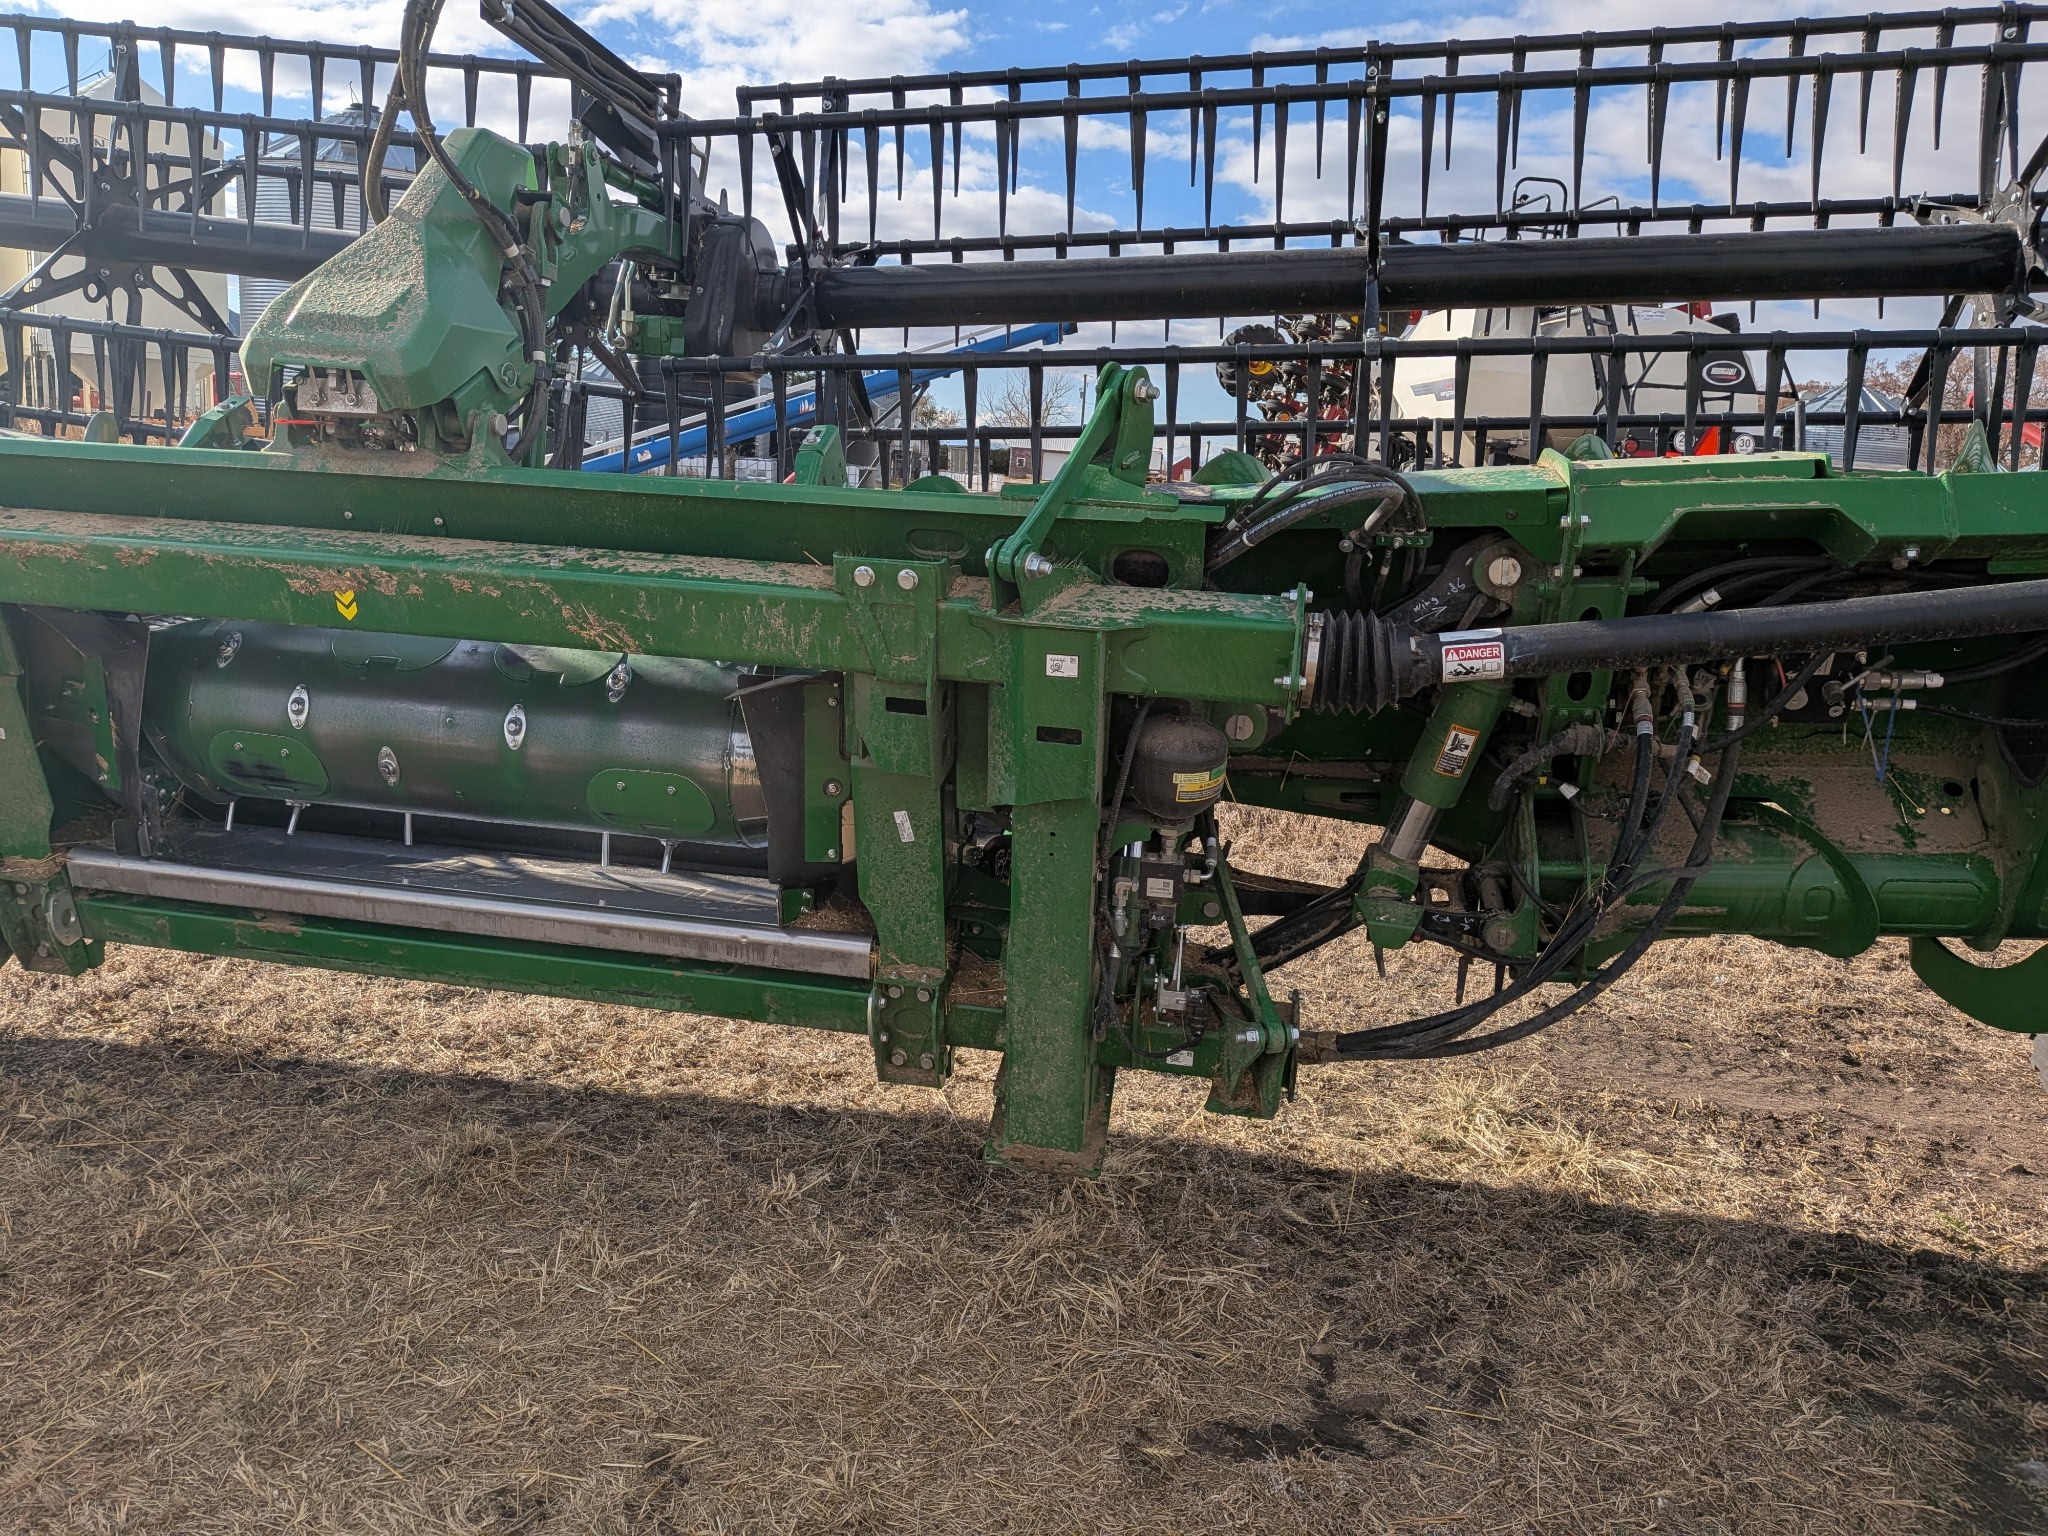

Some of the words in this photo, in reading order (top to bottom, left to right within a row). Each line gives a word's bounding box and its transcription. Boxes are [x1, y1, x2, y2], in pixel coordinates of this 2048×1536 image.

[1738, 438, 1751, 448] 30
[1413, 596, 1440, 612] wing
[1458, 647, 1501, 659] DANGER
